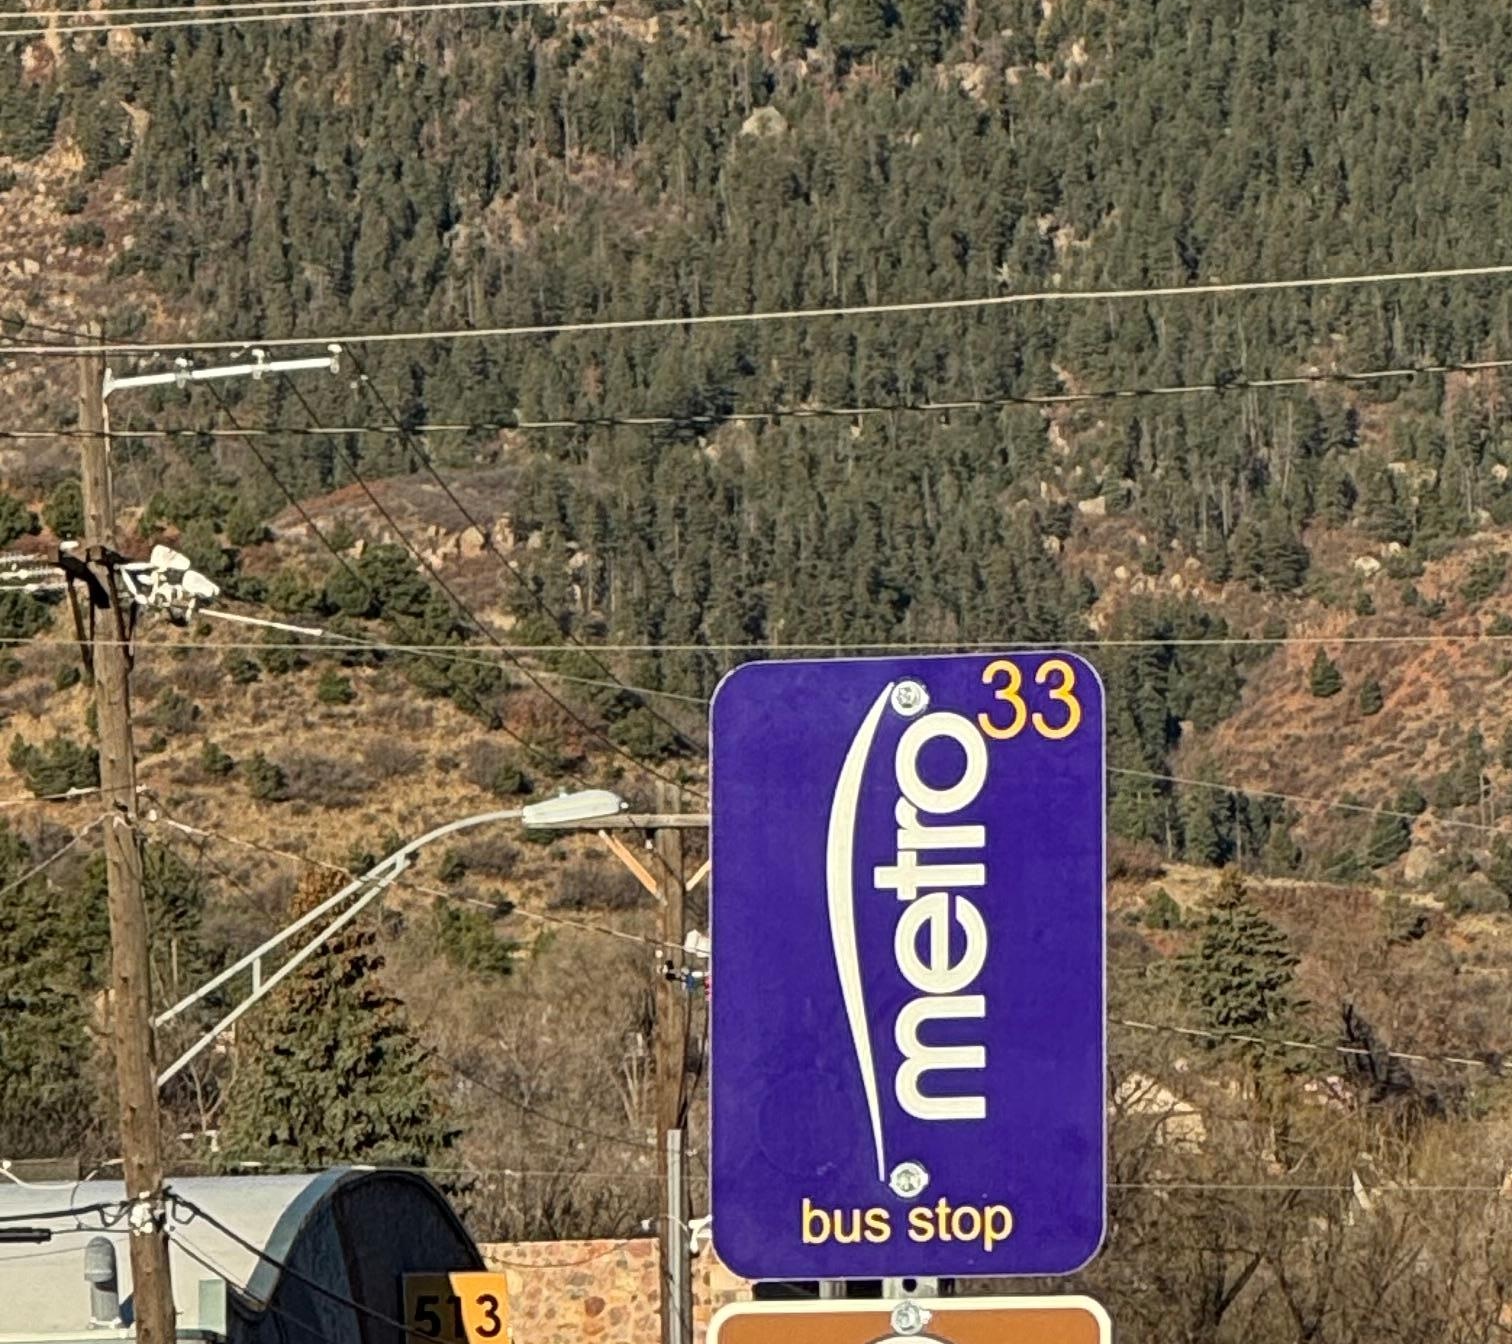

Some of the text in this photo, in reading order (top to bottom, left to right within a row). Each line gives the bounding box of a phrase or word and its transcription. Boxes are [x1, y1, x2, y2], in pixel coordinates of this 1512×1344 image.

[978, 659, 1082, 740] 33
[874, 711, 988, 1120] metro
[802, 1199, 1013, 1252] bus stop
[414, 1294, 502, 1338] 513
